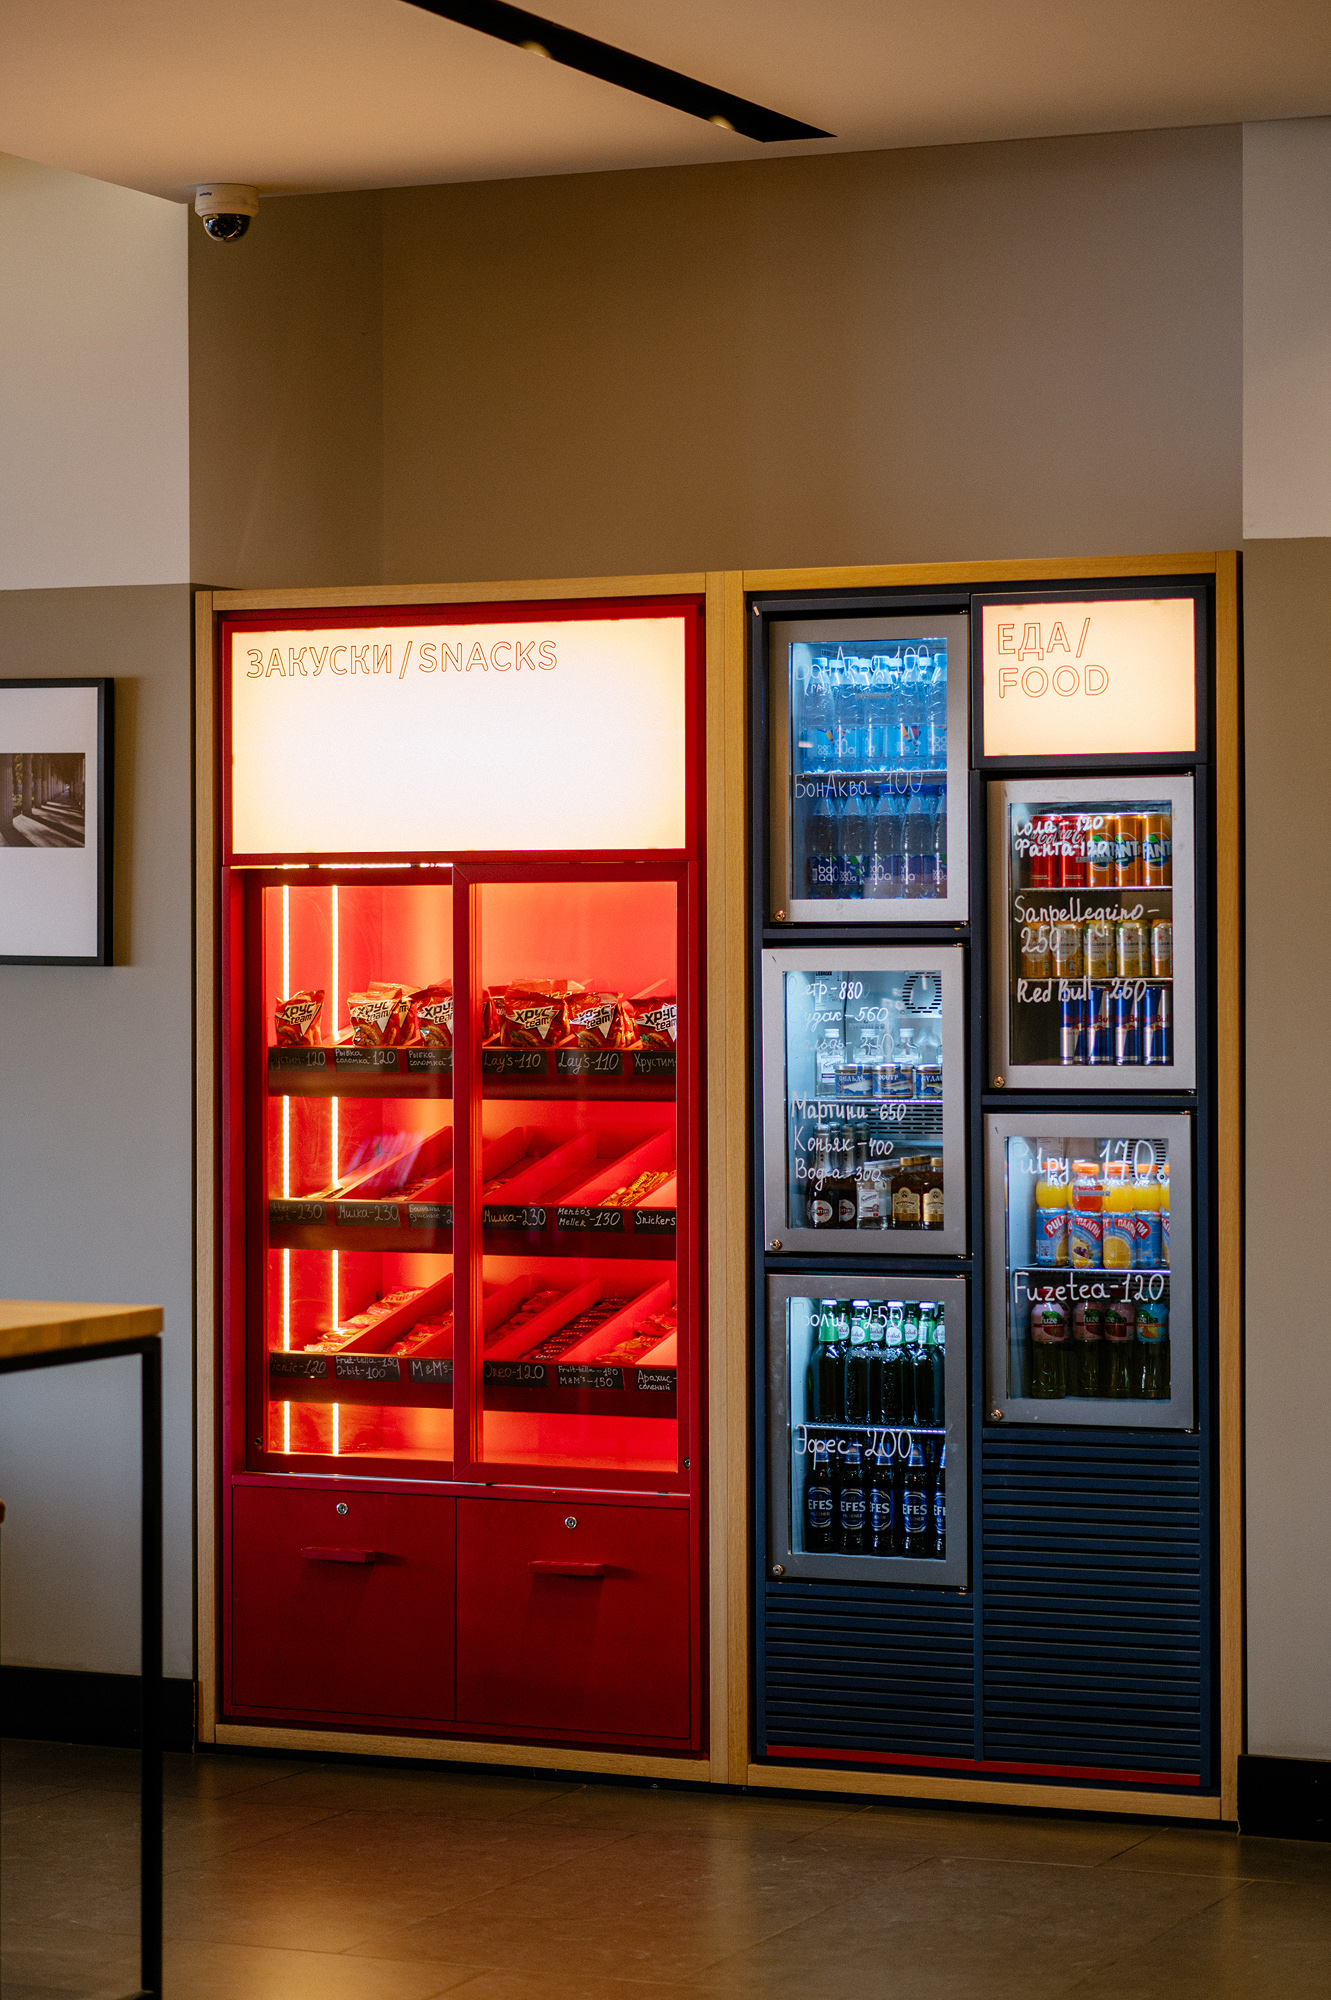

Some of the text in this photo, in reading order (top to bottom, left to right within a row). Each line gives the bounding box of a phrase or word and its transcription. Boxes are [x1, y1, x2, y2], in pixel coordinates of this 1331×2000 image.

[246, 644, 392, 679] ЗАКУСКИ
[418, 640, 558, 673] SNACKS
[999, 665, 1109, 698] FOOD
[1021, 925, 1061, 953] 250
[1017, 975, 1147, 1003] Red Bull 260
[635, 1210, 676, 1226] Snickers
[808, 1499, 833, 1510] EFES
[840, 1500, 866, 1512] EFES
[902, 1504, 928, 1515] EFES
